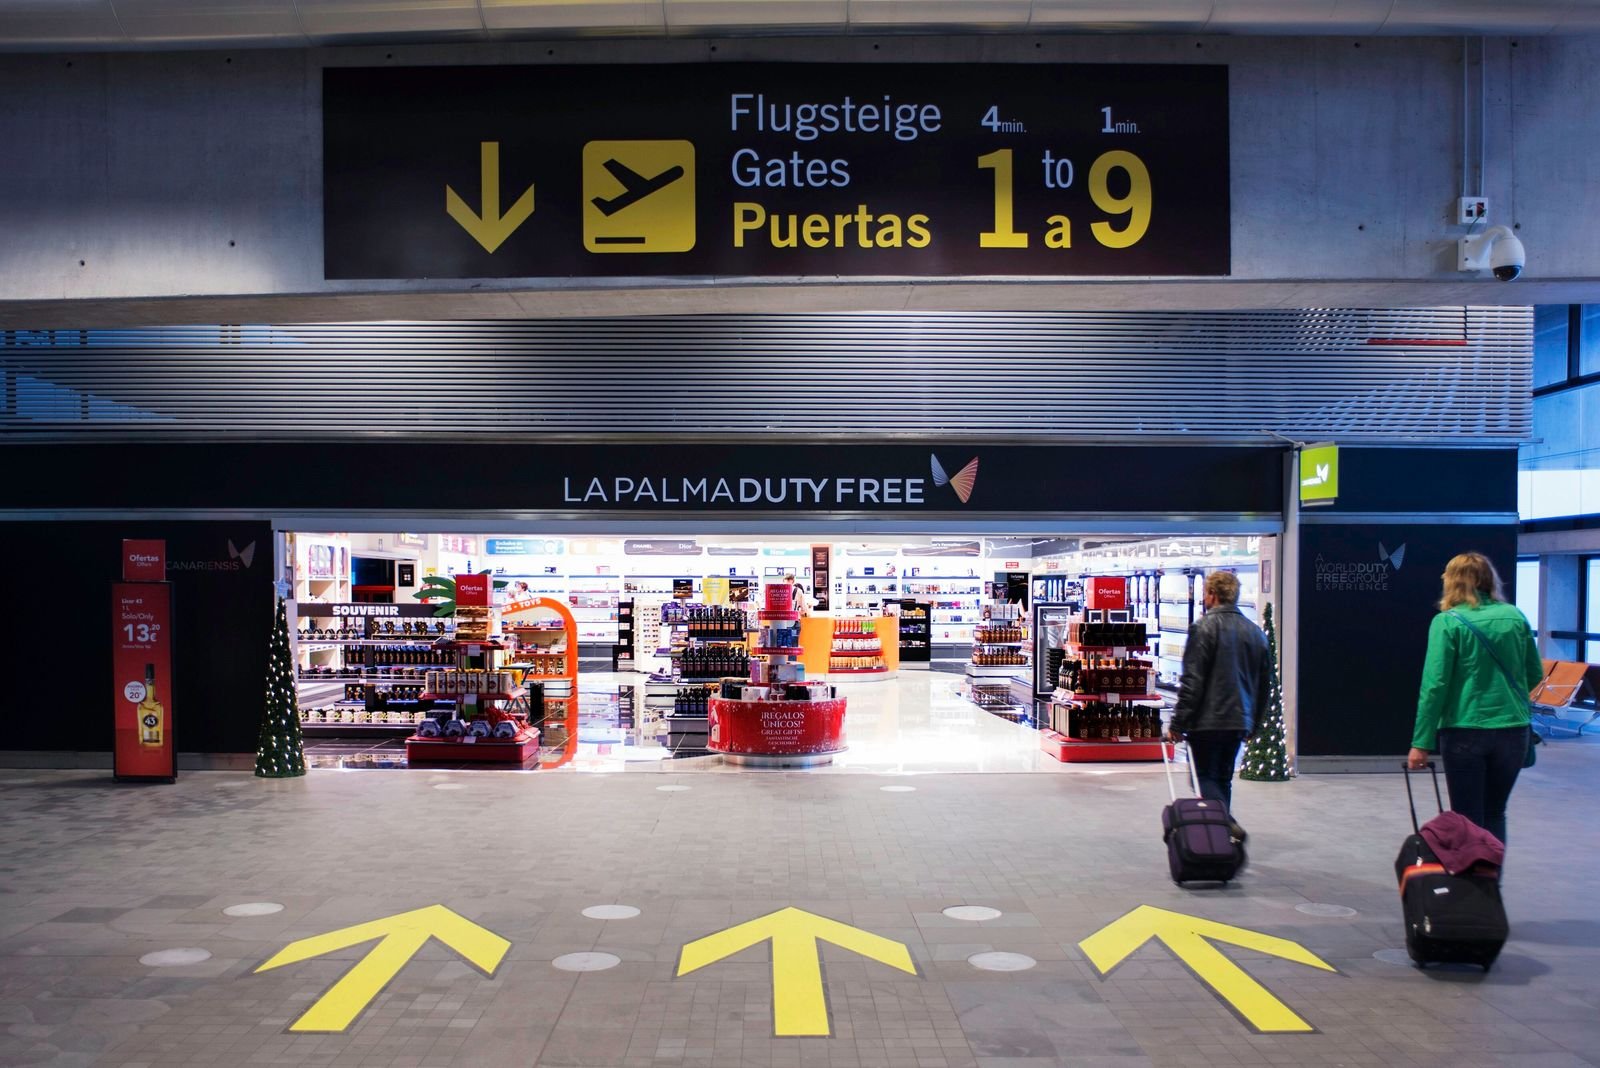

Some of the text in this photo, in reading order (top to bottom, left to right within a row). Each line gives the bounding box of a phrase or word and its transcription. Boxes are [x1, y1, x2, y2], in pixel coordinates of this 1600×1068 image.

[731, 94, 942, 141] Flugsteige
[731, 147, 851, 187] Gates
[977, 148, 1153, 249] 1 to 9
[733, 202, 1072, 249] Puertas a
[836, 478, 925, 503] FREE
[129, 554, 160, 562] Ofertas
[1315, 552, 1324, 562] A
[460, 584, 484, 592] Ofertas
[1316, 583, 1388, 591] EXPERIENCE
[519, 598, 542, 610] TOYS
[332, 605, 399, 616] SOUVENIR
